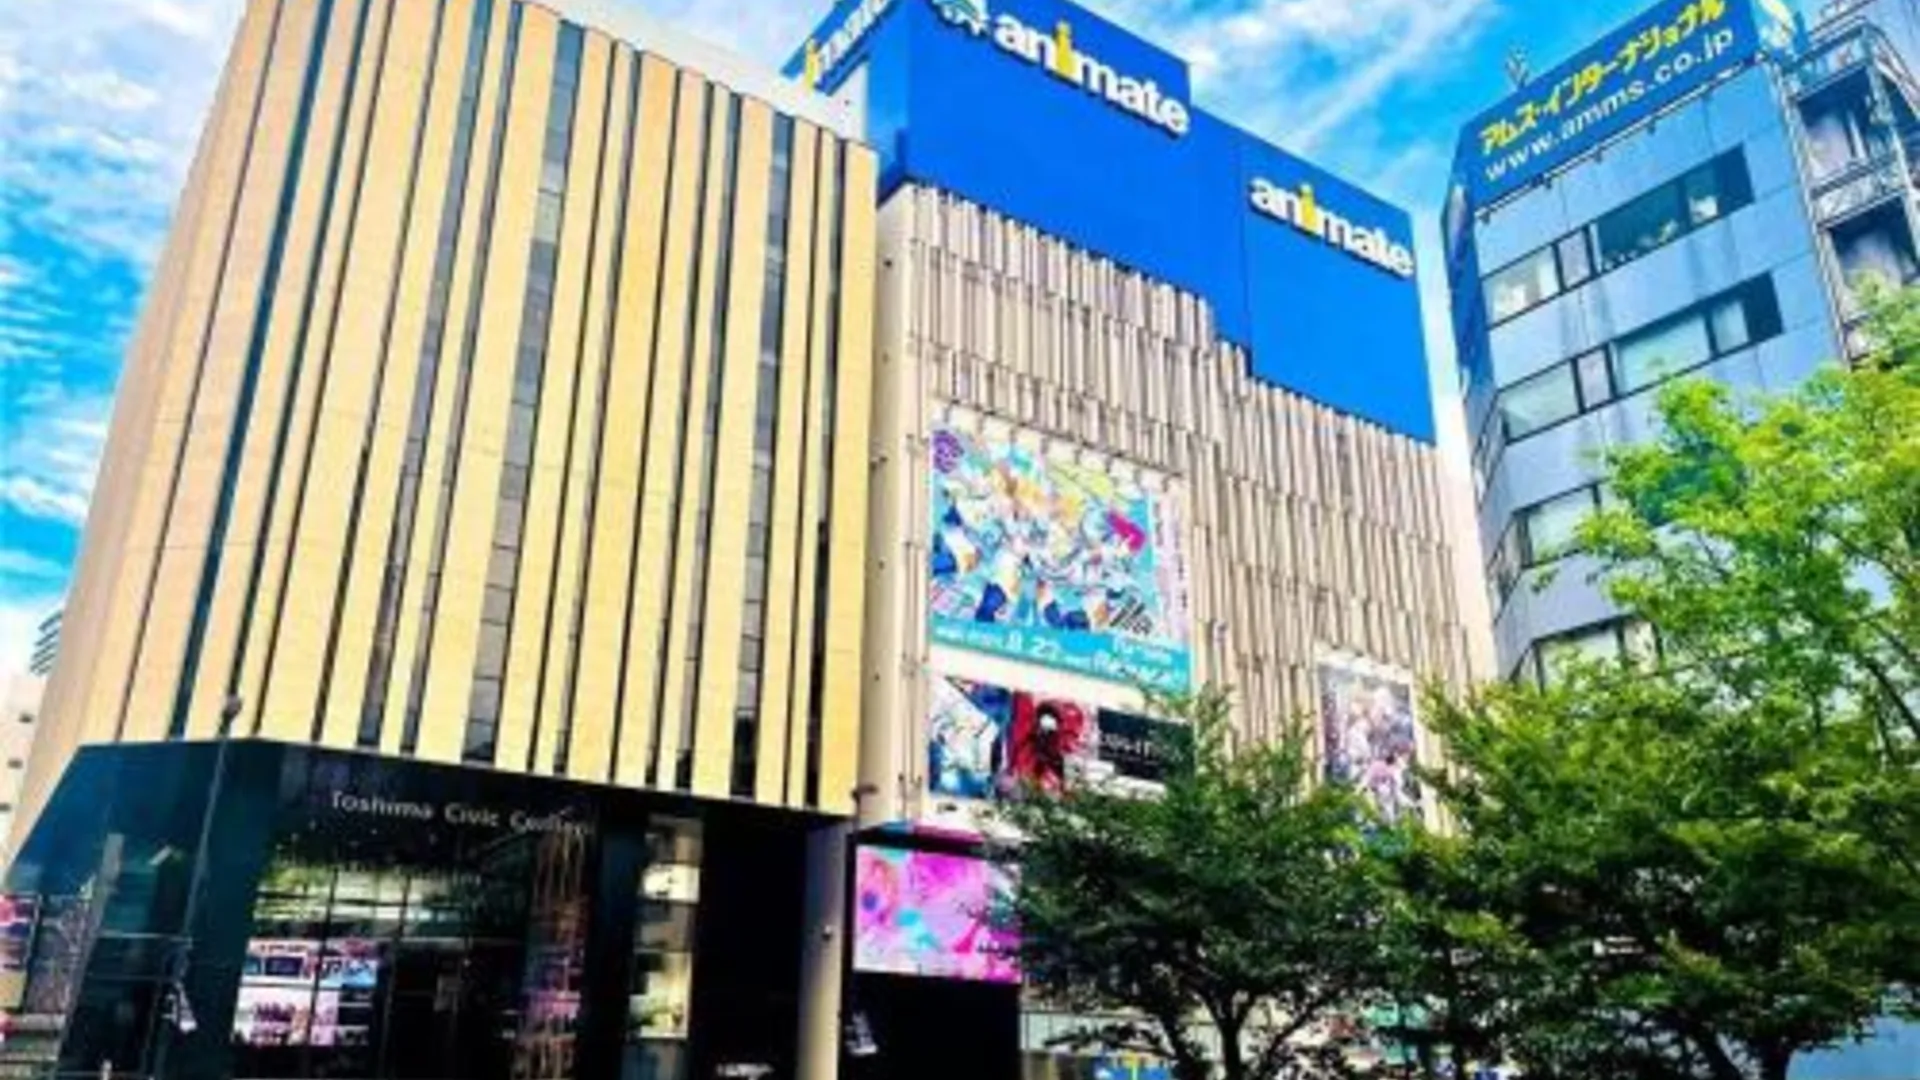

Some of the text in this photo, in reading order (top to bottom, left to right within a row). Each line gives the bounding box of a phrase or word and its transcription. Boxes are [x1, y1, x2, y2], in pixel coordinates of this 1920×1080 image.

[994, 13, 1190, 134] animate
[1484, 29, 1734, 182] www.amms.co.jp
[1251, 177, 1414, 277] animate
[333, 790, 434, 820] Toshima
[444, 803, 500, 828] Civic
